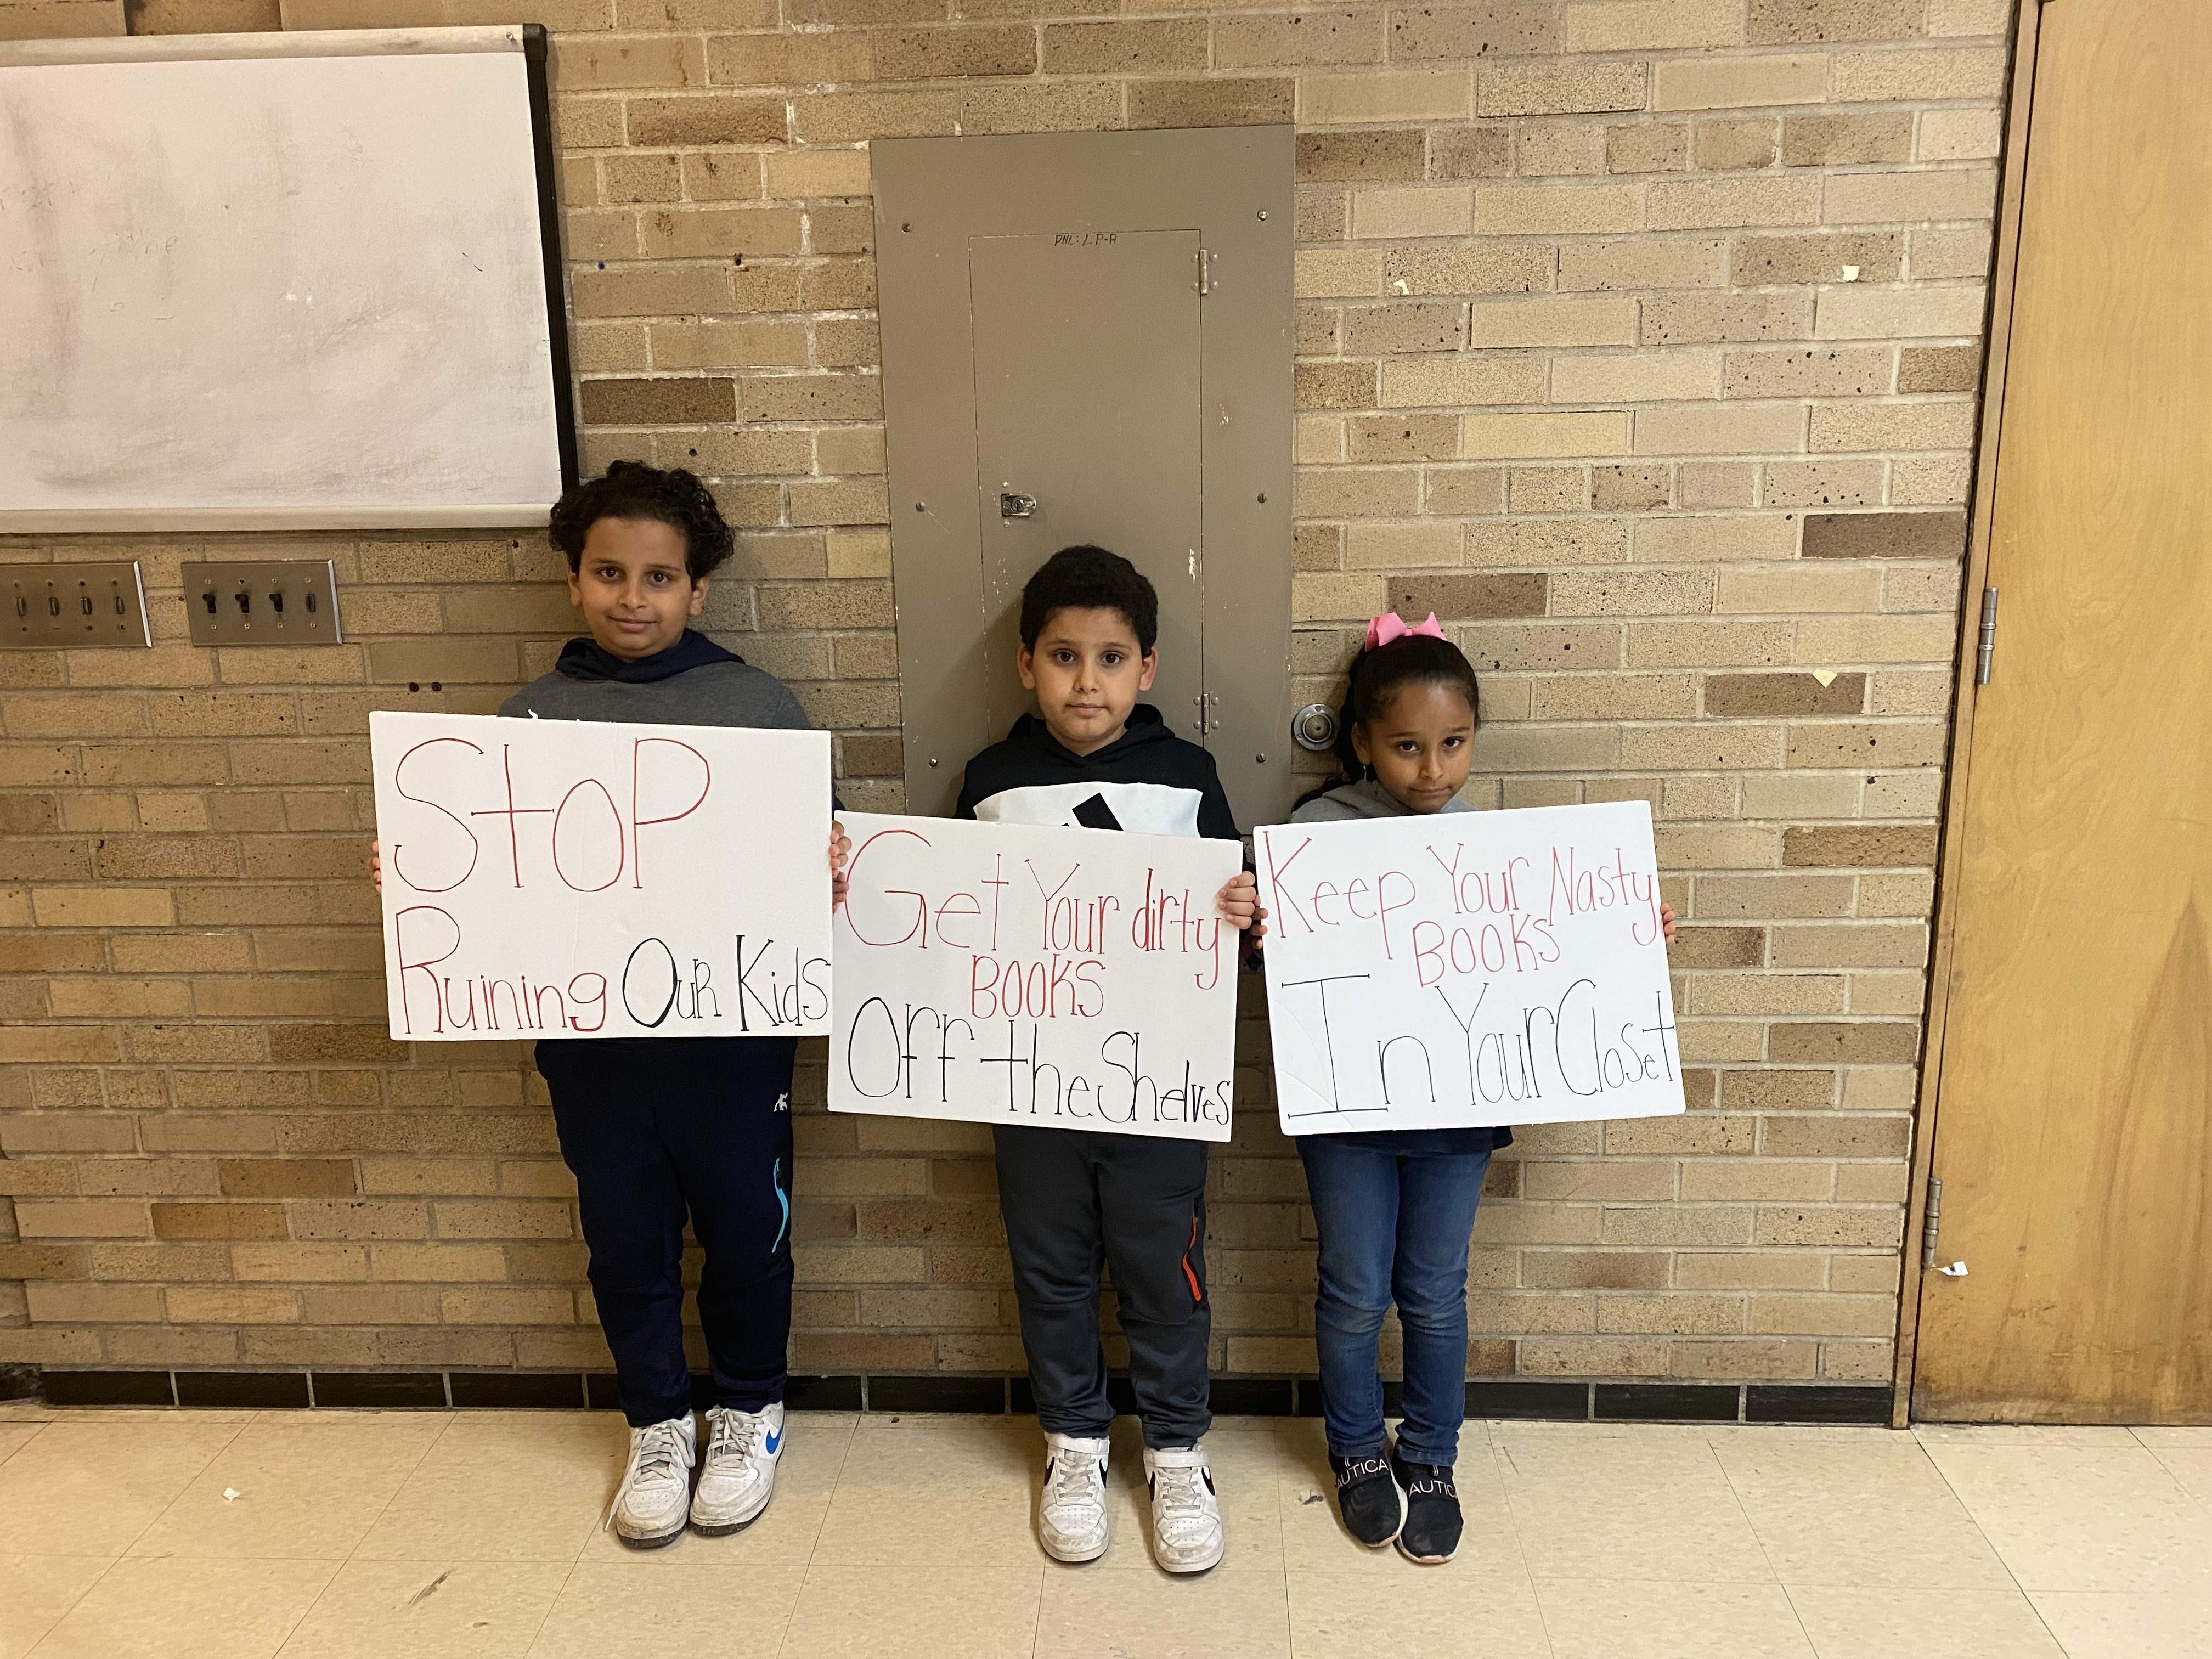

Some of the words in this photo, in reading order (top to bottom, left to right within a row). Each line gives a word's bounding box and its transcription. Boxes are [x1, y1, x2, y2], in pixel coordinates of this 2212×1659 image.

[844, 829, 1009, 951] Get
[1024, 859, 1120, 955] Your
[1131, 867, 1221, 990] dirty
[1262, 830, 1416, 959] Keep
[1427, 843, 1530, 914] Your
[1548, 846, 1657, 946] Nasty
[396, 905, 607, 1035] Ruining
[980, 1019, 1092, 1118] the
[1097, 1031, 1231, 1126] Shelves
[1281, 973, 1436, 1119] In
[1434, 982, 1554, 1105] Your
[1555, 978, 1675, 1096] Closet
